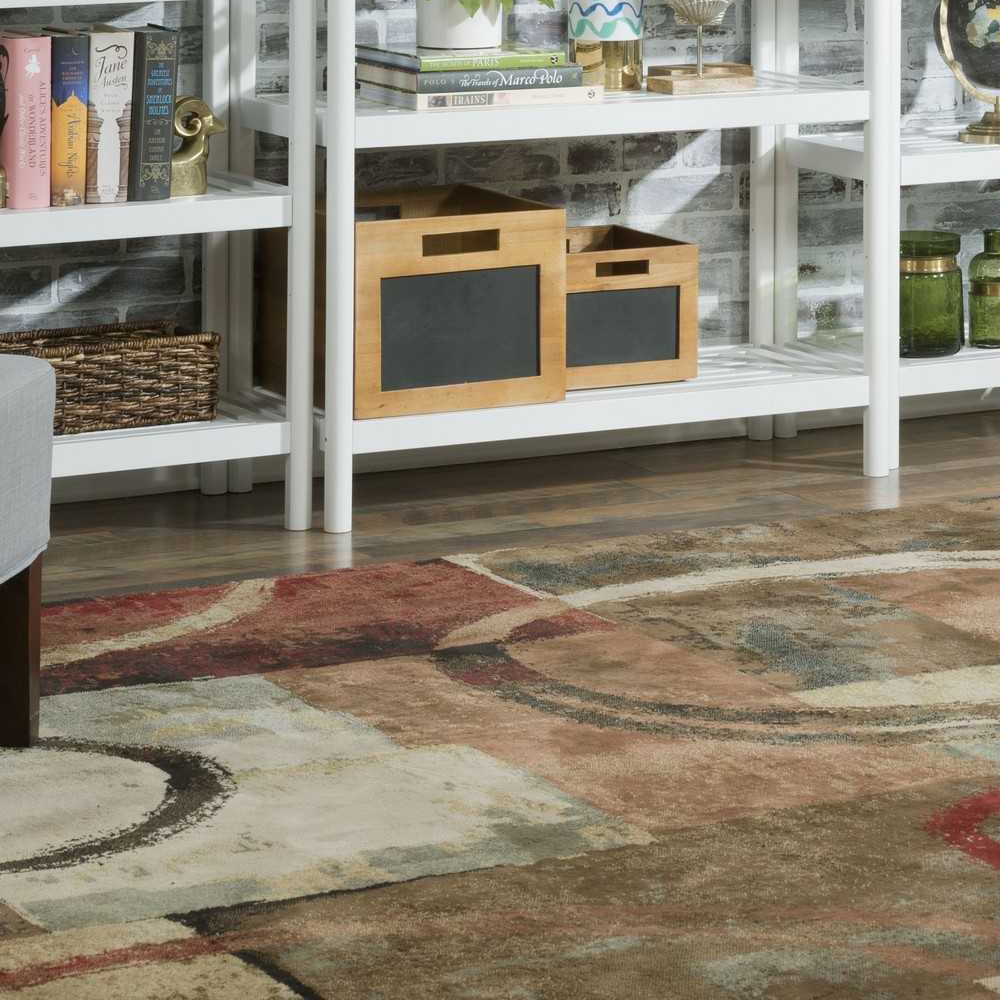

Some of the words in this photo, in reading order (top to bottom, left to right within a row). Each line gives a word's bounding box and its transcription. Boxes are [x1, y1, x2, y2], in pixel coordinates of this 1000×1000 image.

[96, 56, 127, 80] Jane
[473, 56, 499, 67] PARIS
[487, 70, 536, 86] Marco
[491, 78, 499, 88] of
[533, 68, 563, 85] Polo
[28, 104, 36, 168] WONDERLAND
[39, 118, 47, 177] ADVENTURES
